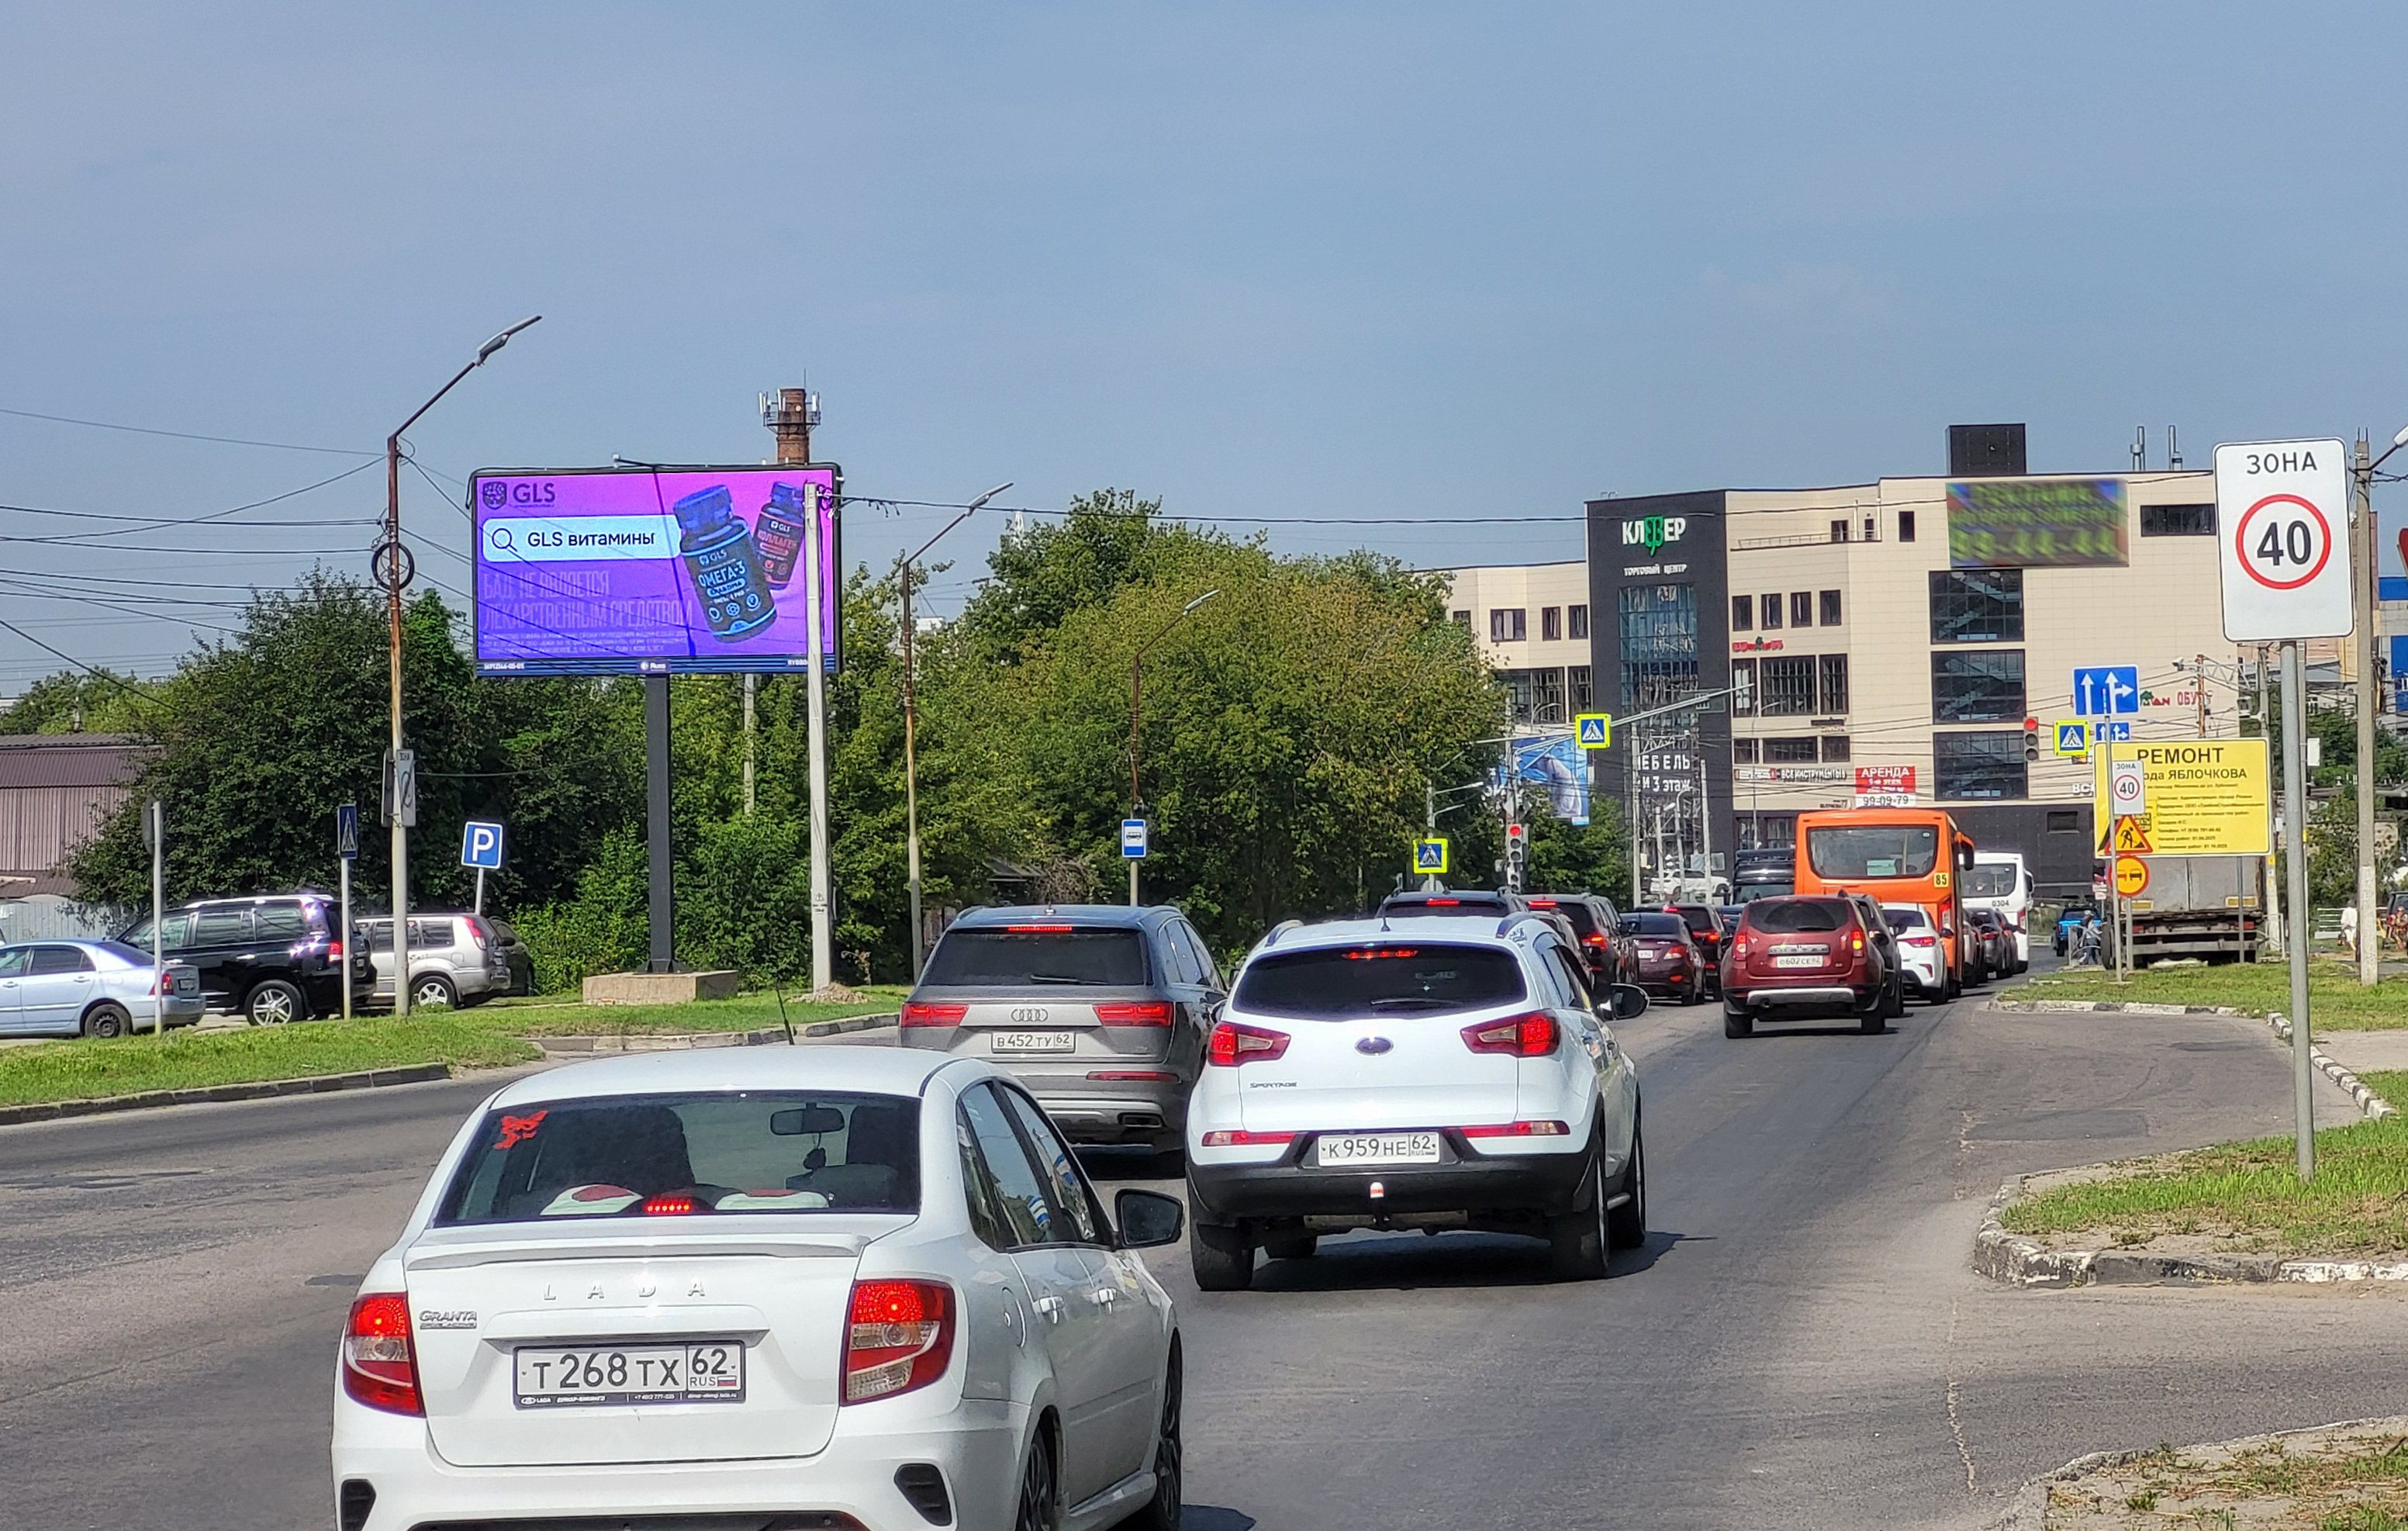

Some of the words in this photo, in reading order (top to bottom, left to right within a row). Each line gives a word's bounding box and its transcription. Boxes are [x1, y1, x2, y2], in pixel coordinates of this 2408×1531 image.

[2246, 451, 2317, 475] ЗОНА
[513, 482, 555, 503] GLS
[527, 532, 563, 547] GLS
[568, 532, 655, 547] витамины
[2257, 520, 2312, 566] 40
[698, 560, 746, 587] ОМЕГА-3
[2137, 747, 2224, 765] РЕМОНТ
[1861, 766, 1911, 779] АРЕНДА
[2168, 768, 2248, 780] ЯБЛОЧКОВА
[2120, 782, 2135, 795] 40
[1936, 875, 1947, 886] 85
[1055, 1033, 1070, 1044] 62
[1411, 1135, 1432, 1150] 62
[543, 1280, 707, 1301] LADA
[420, 1310, 478, 1322] GRANTA
[691, 1348, 728, 1375] 62
[689, 1376, 717, 1387] RUS
